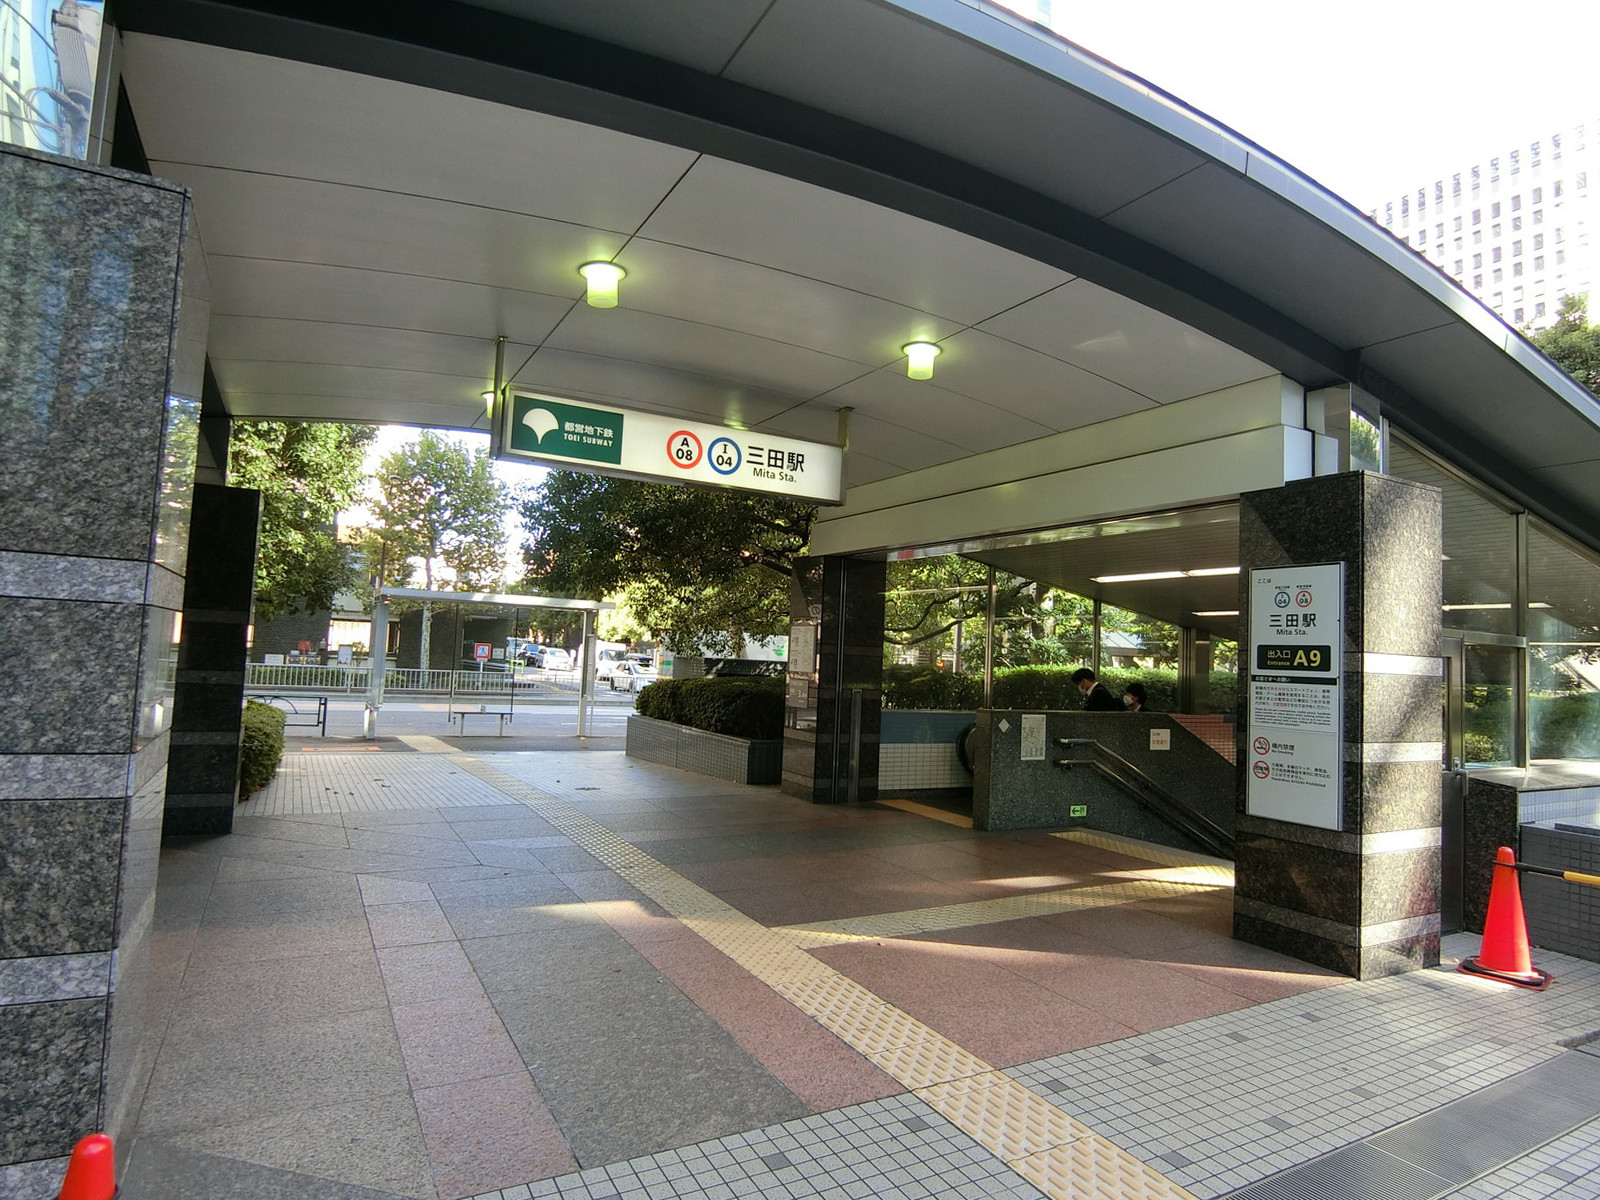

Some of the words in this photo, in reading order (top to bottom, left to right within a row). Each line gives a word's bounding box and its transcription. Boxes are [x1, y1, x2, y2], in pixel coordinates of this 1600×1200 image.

[564, 421, 613, 438] 都営地下鉄
[563, 433, 580, 442] TOEI
[582, 435, 613, 447] SUBWAY
[680, 437, 690, 448] A
[676, 448, 693, 461] 08
[716, 454, 733, 467] 04
[746, 445, 805, 473] 三田駅
[752, 467, 776, 480] Mita
[778, 471, 797, 483] Sta.
[1269, 613, 1316, 627] 三田駅
[1267, 650, 1291, 658] 出入口
[1293, 649, 1321, 667] A9
